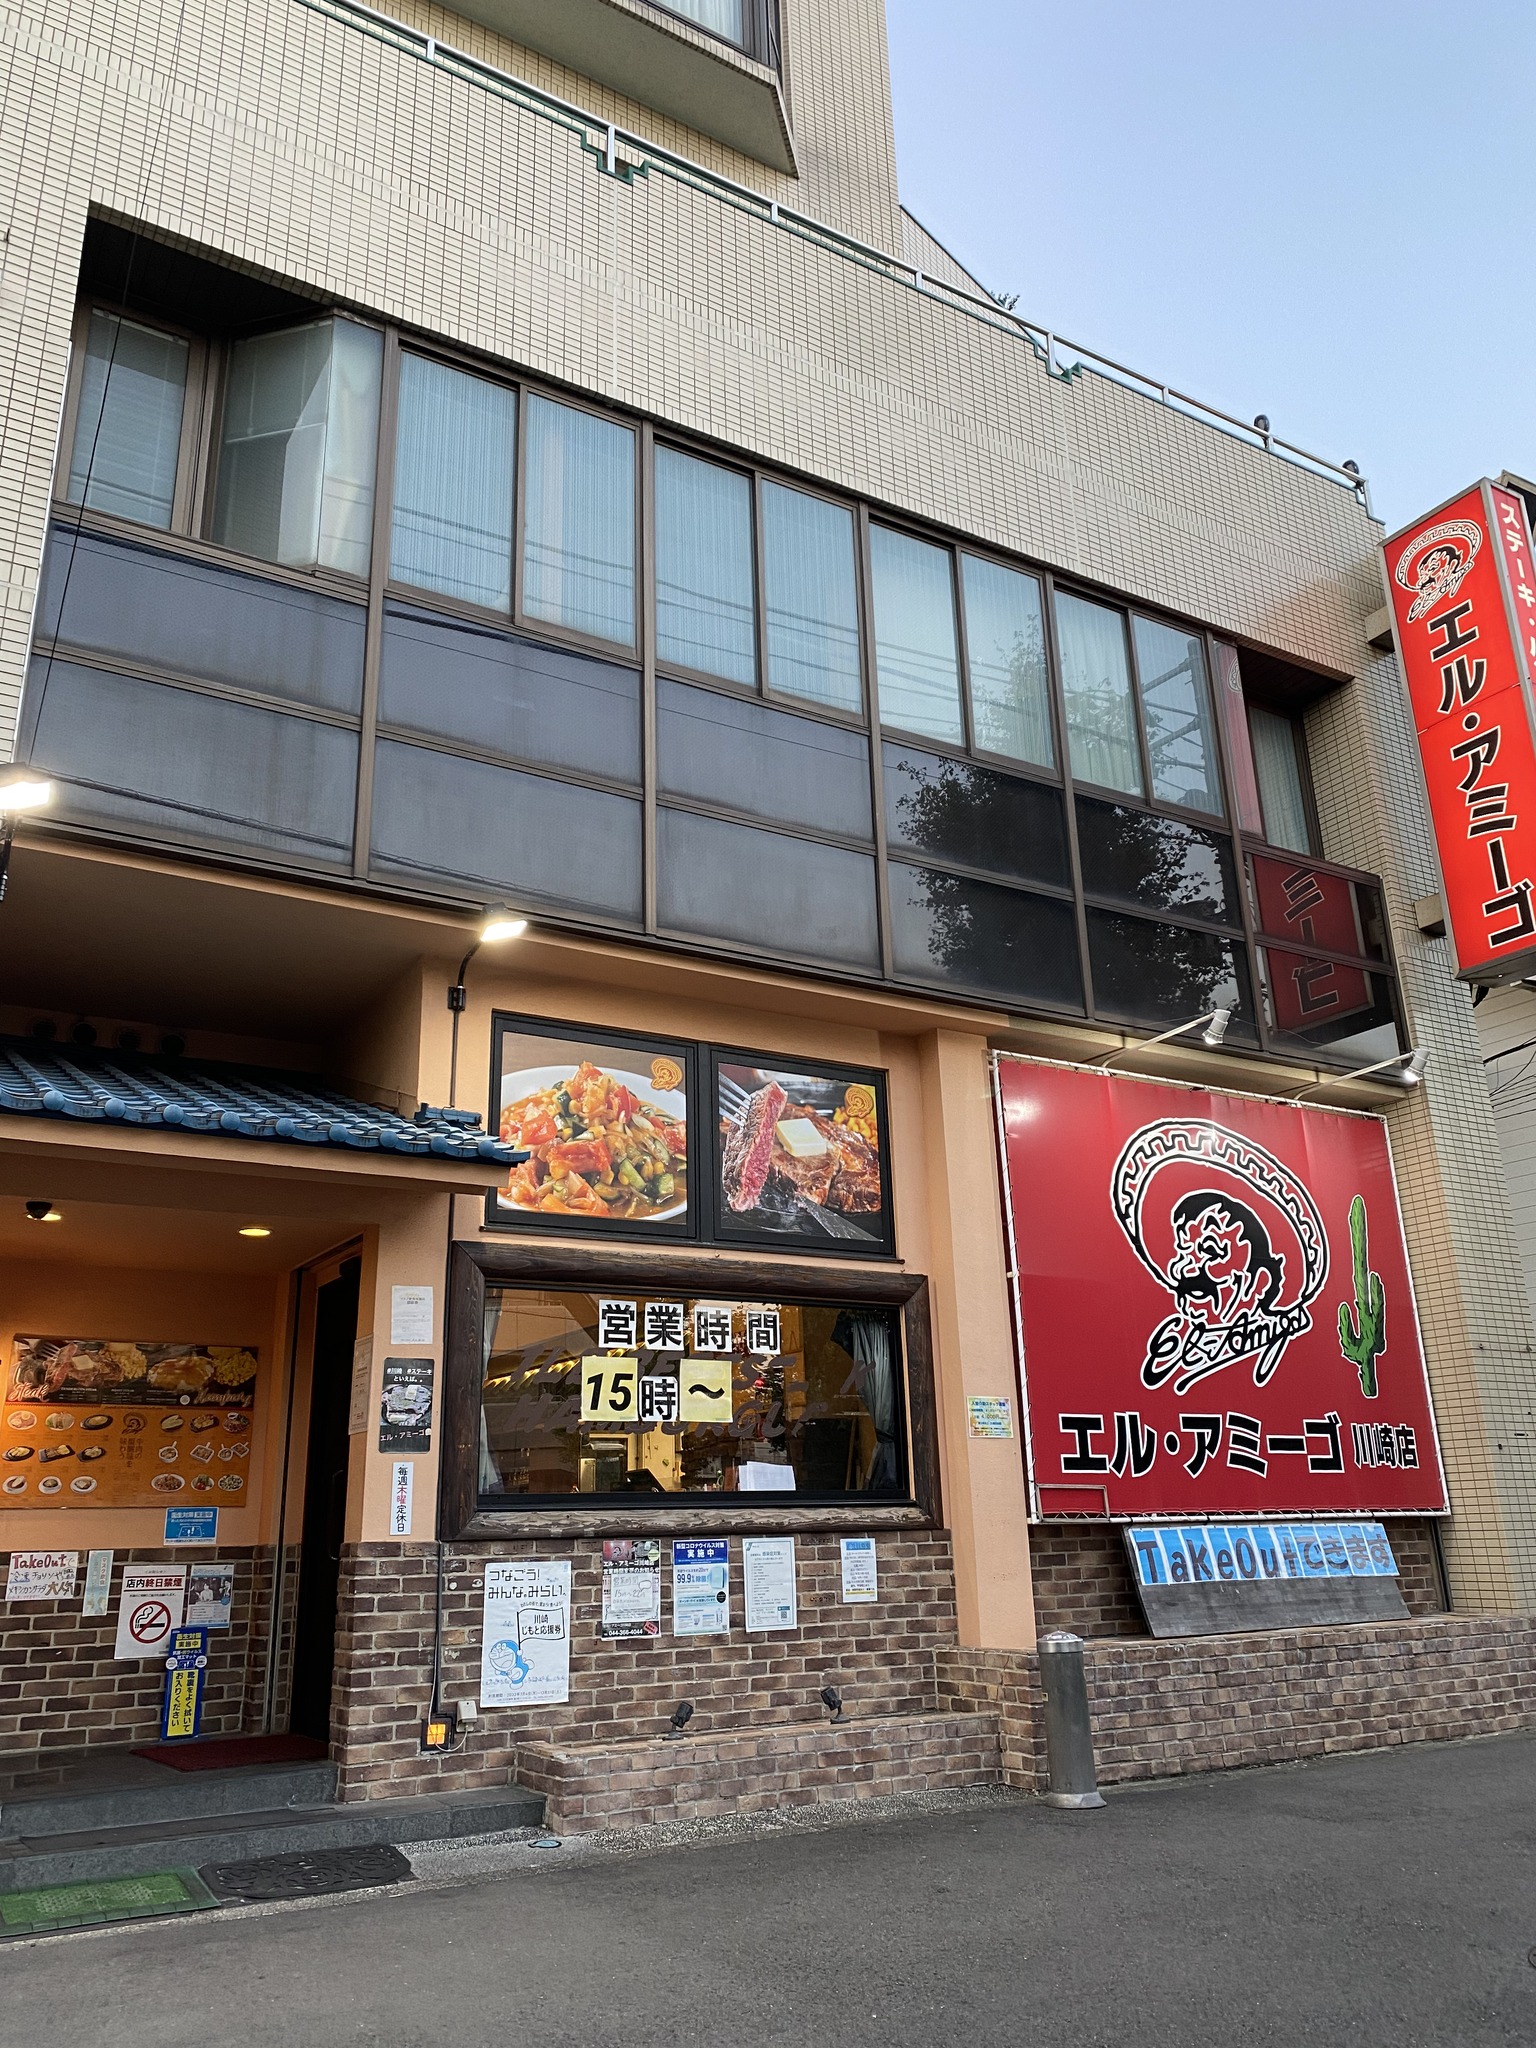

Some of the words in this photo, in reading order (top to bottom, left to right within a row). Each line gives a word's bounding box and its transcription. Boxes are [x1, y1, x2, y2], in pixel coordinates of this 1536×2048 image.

[1427, 599, 1535, 949] エル・アミーゴ
[601, 1303, 778, 1351] 営業時間
[8, 1382, 50, 1402] Steak
[1058, 1411, 1345, 1478] エル・アミーゴ
[1350, 1422, 1420, 1470] 川崎店
[395, 1466, 409, 1533] 毎週木曜定休日
[126, 1578, 182, 1588] 店内終日禁煙
[171, 1672, 183, 1727] お入りください
